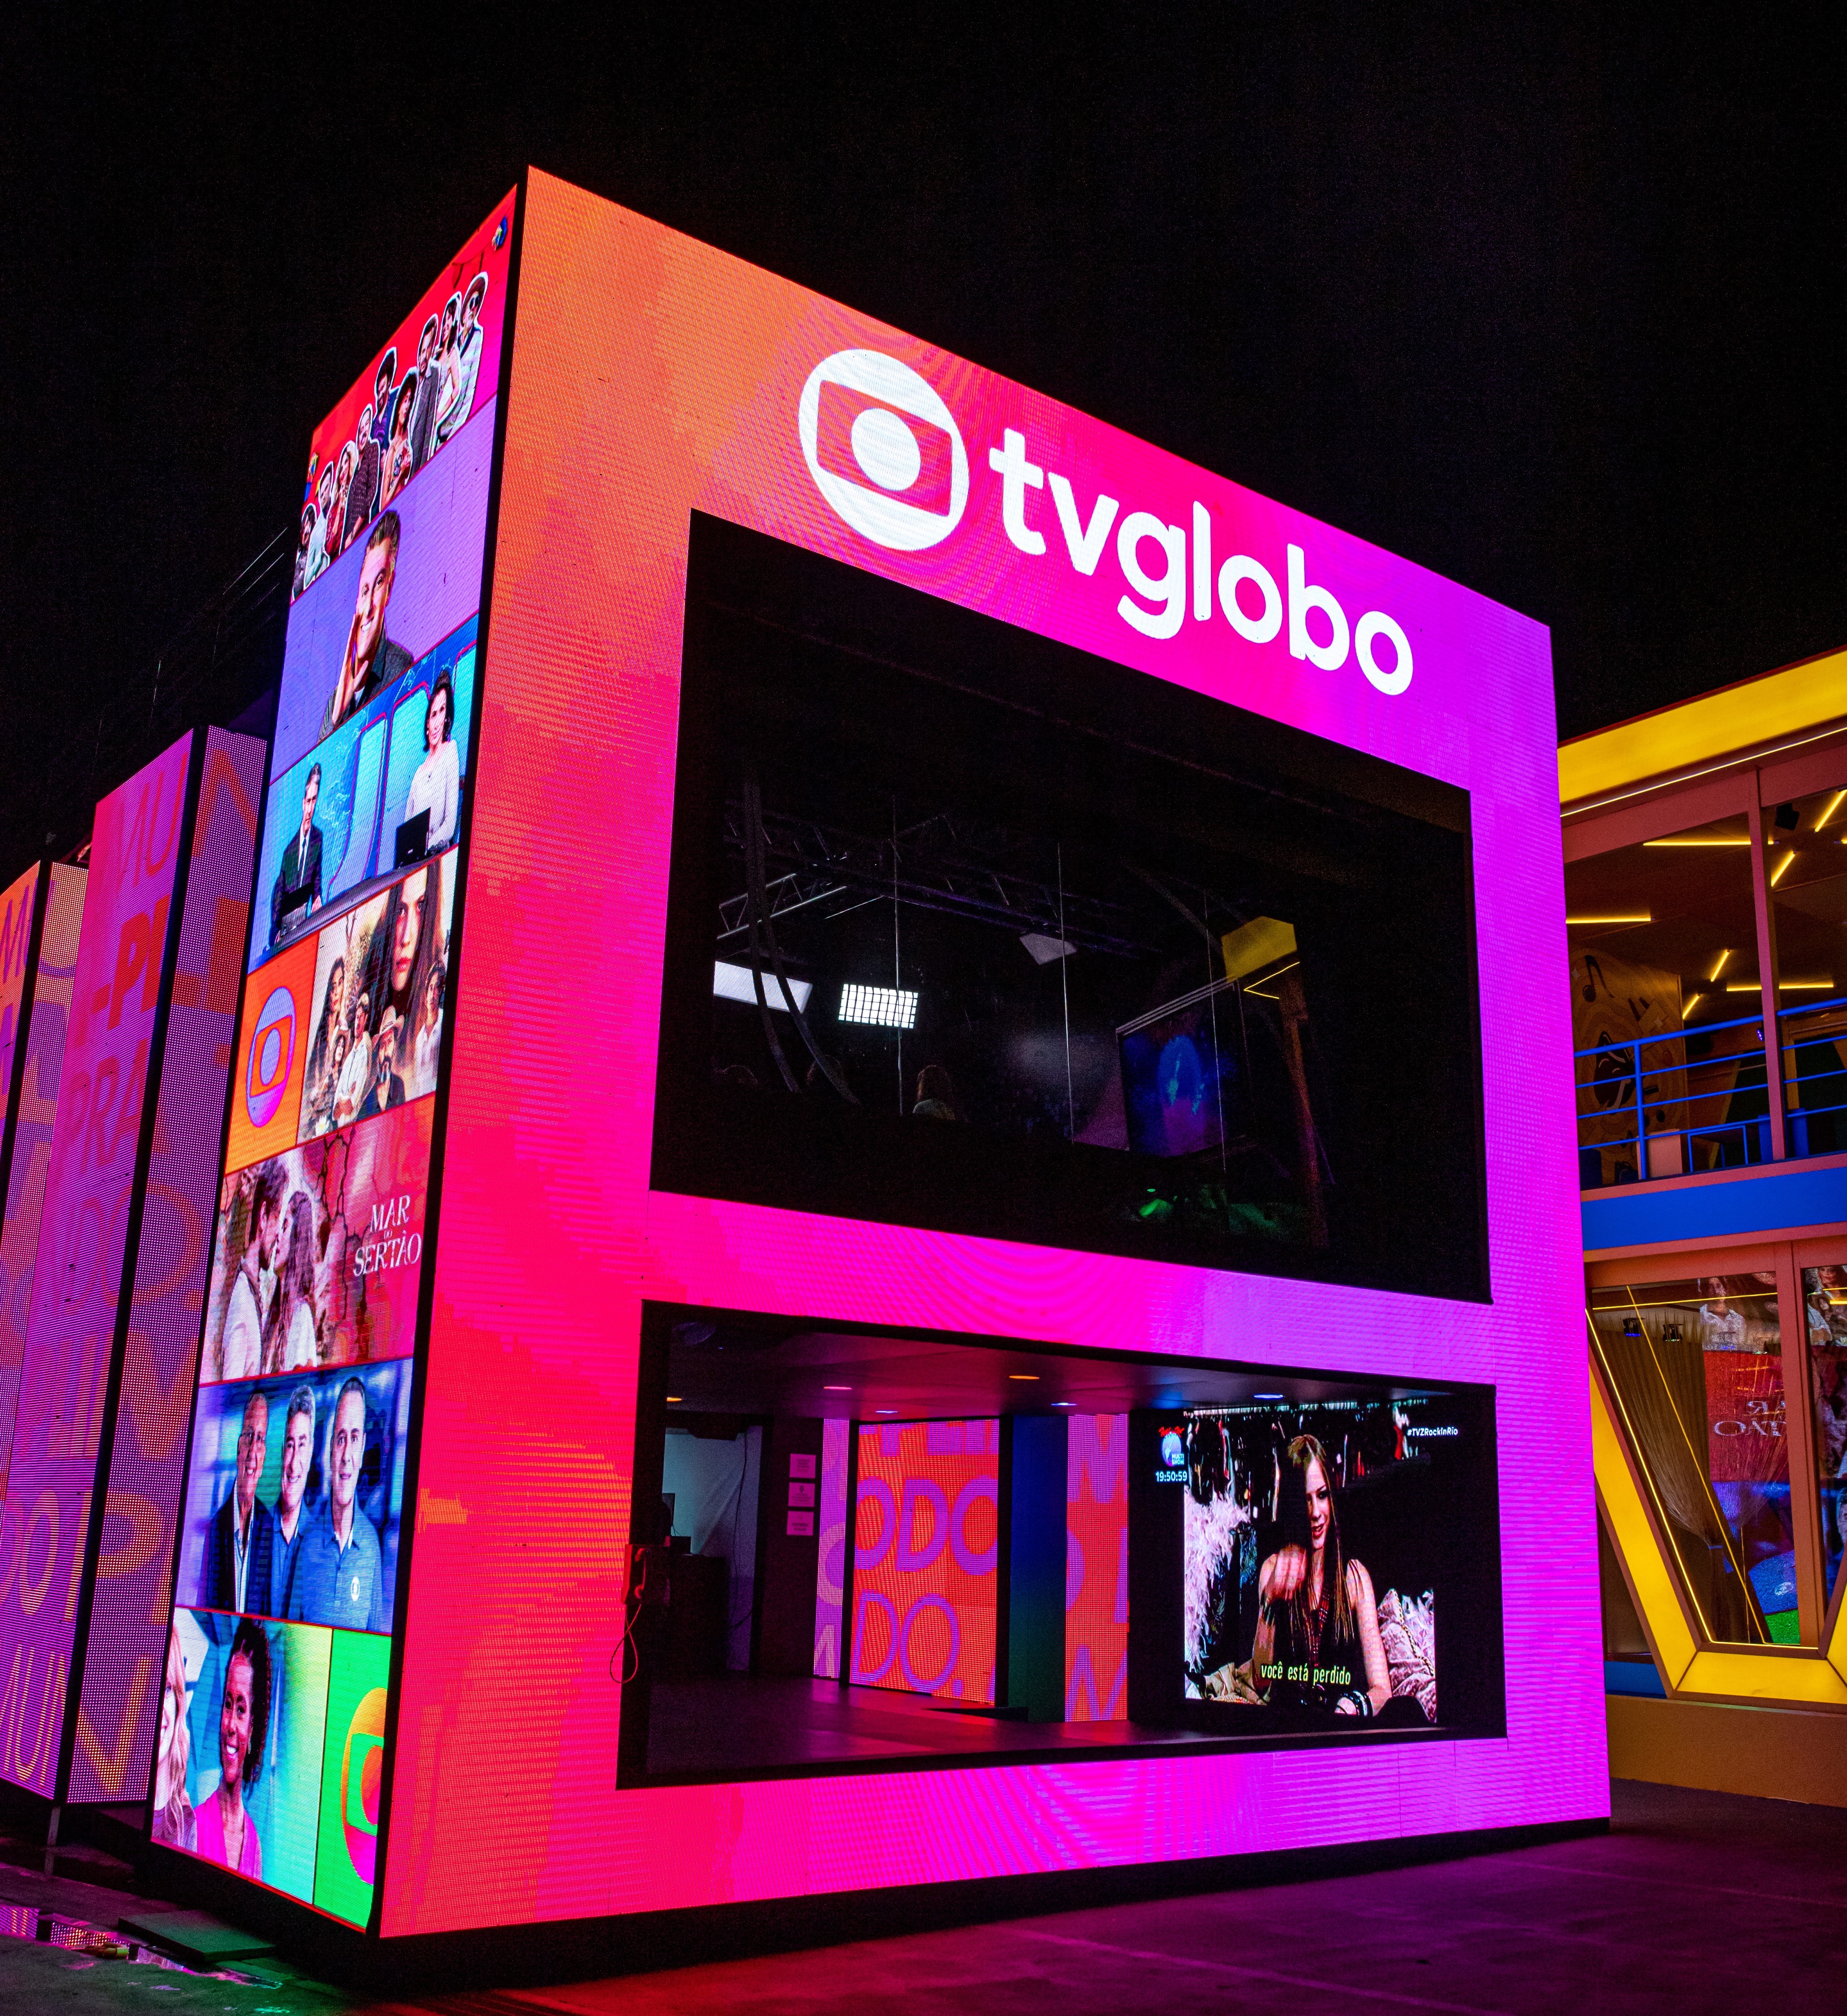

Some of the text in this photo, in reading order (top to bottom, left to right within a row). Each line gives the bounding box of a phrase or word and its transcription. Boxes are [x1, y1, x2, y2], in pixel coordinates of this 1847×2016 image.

[989, 428, 1413, 696] tvglobo
[370, 1195, 411, 1232] MAR
[353, 1230, 422, 1276] SERTÃO
[1155, 1471, 1187, 1481] 19:50:59
[1261, 1661, 1351, 1686] você está perdido
